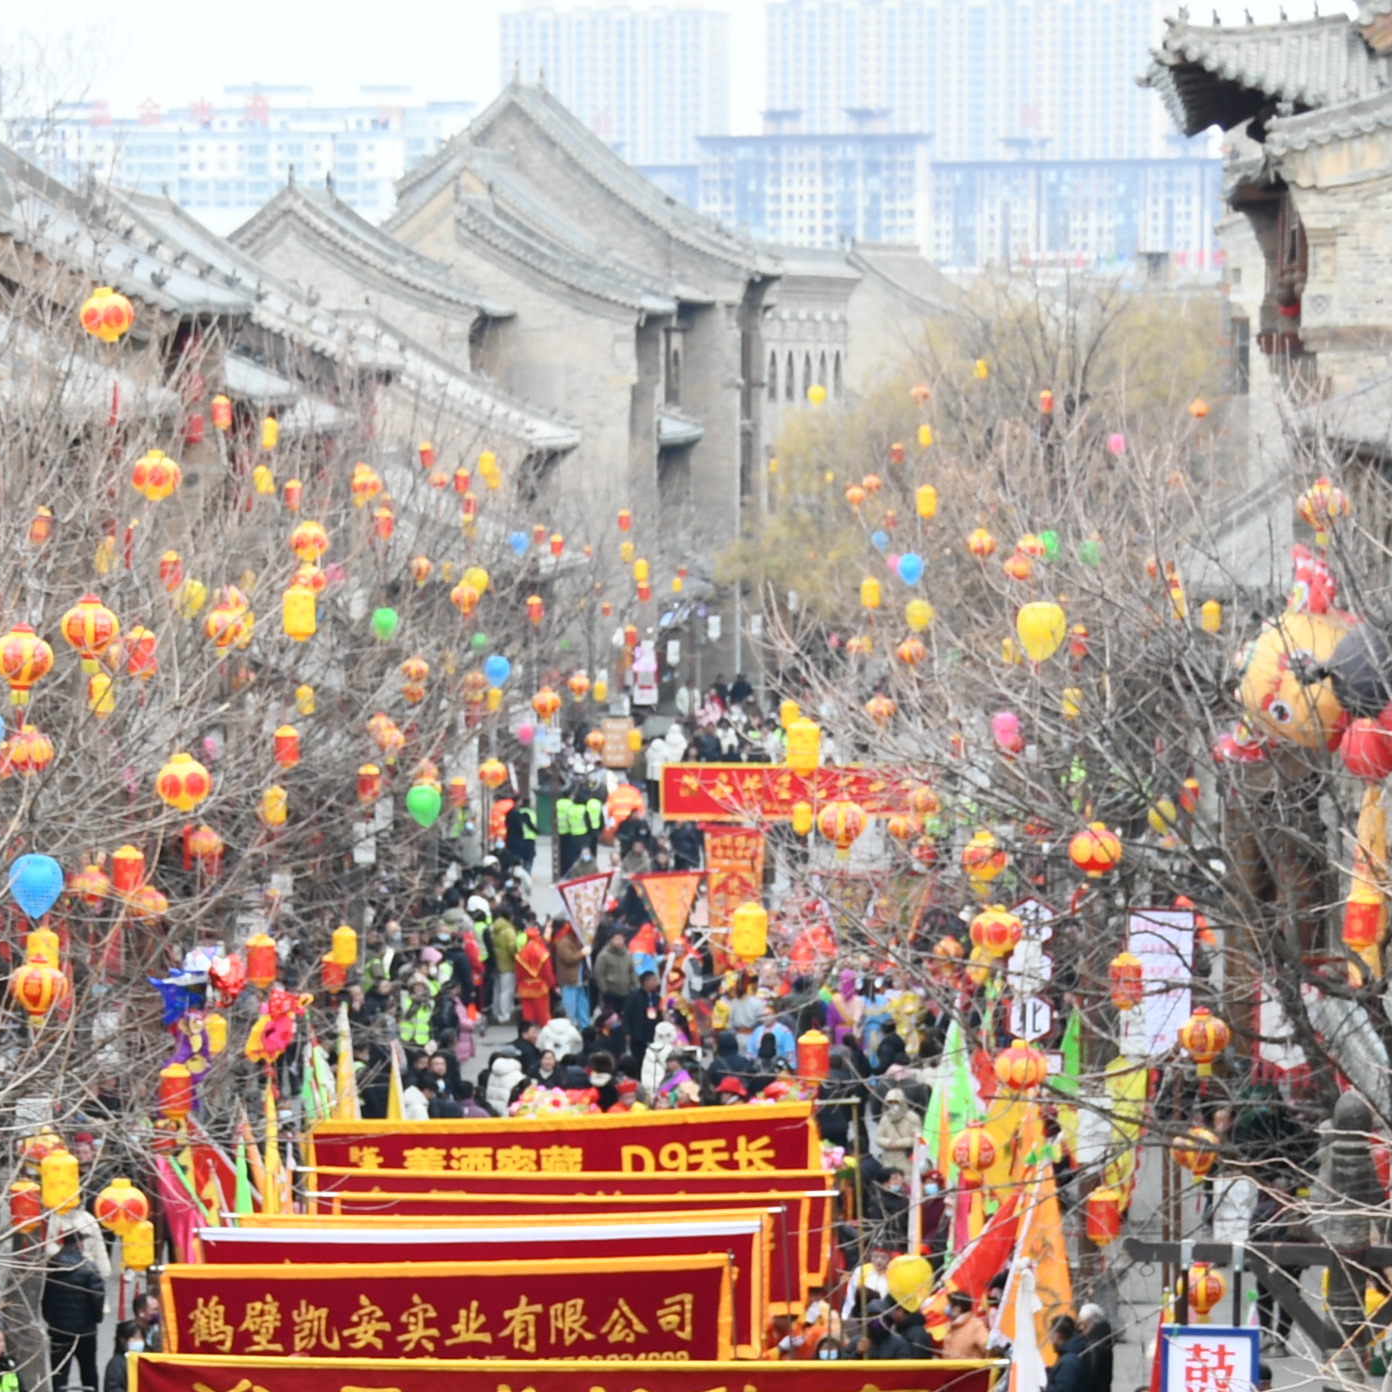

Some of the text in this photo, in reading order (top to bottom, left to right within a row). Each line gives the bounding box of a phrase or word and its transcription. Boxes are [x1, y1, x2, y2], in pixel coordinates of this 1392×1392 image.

[188, 1292, 696, 1354] 鹤壁凯安实业有限公司
